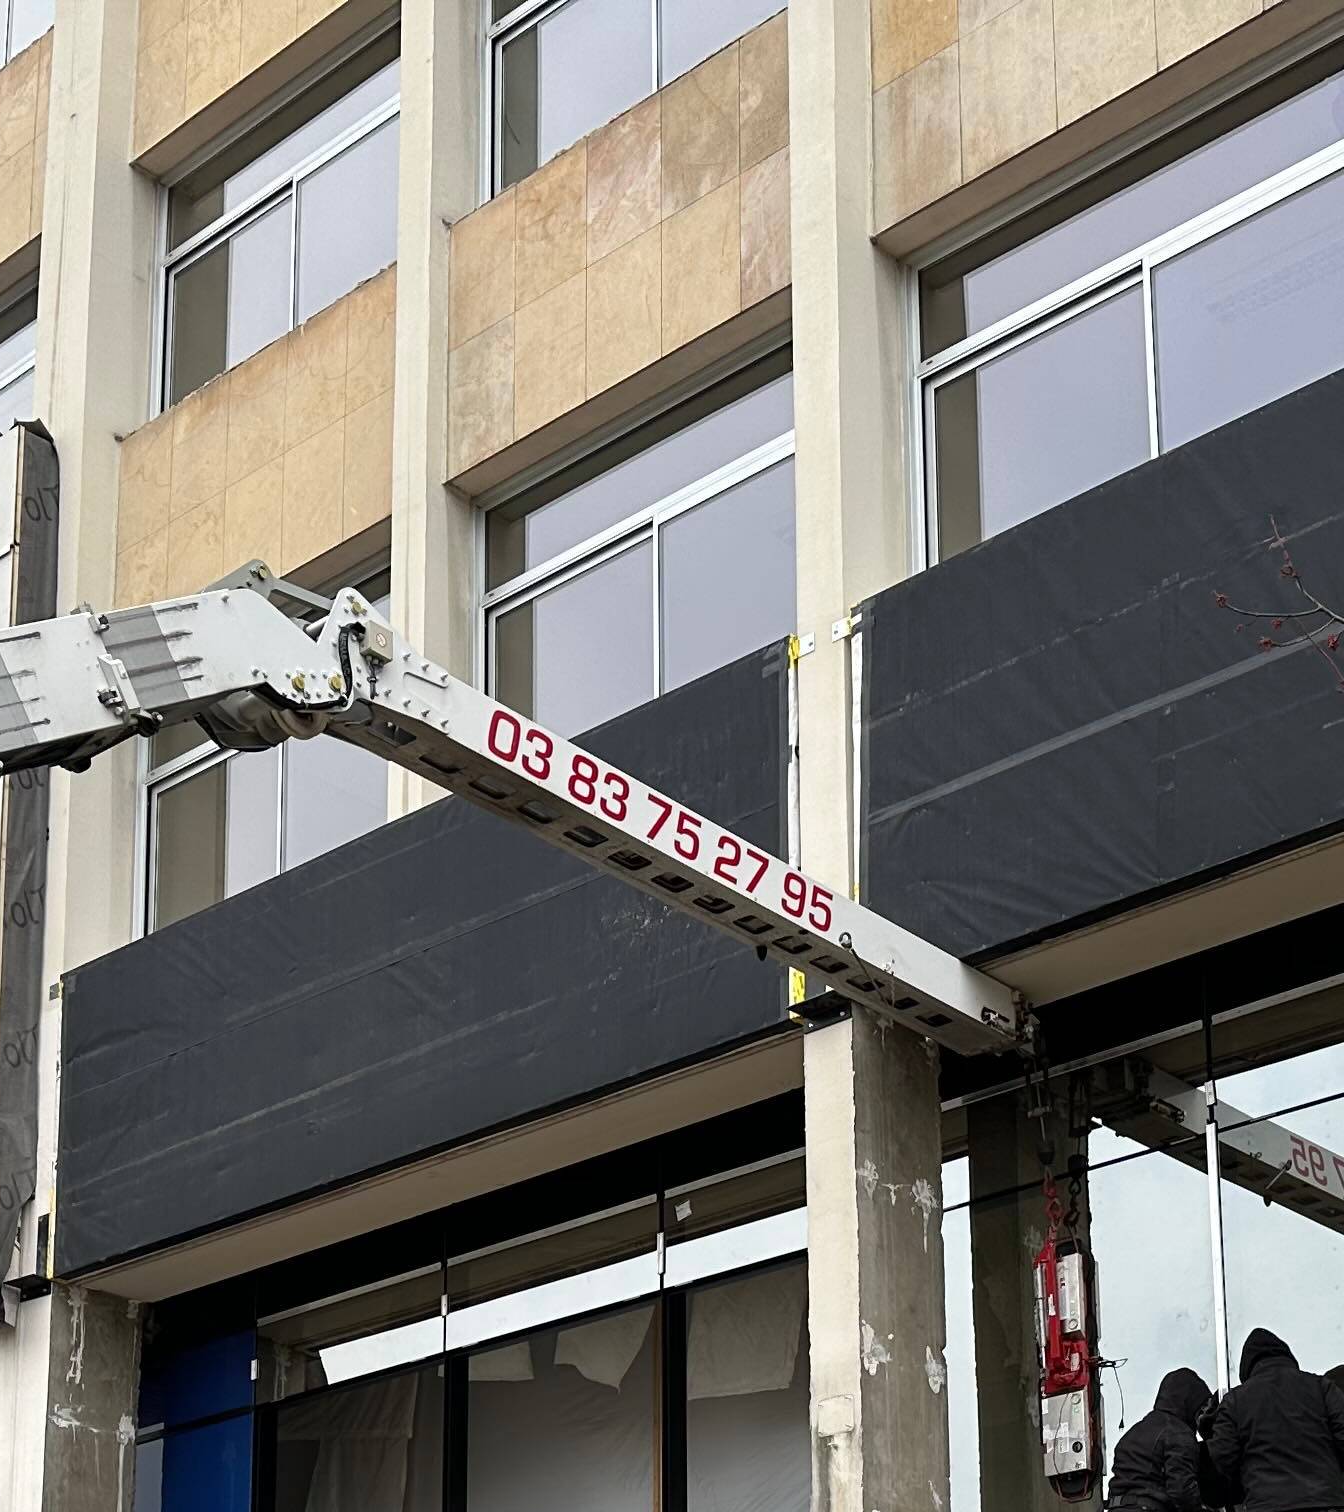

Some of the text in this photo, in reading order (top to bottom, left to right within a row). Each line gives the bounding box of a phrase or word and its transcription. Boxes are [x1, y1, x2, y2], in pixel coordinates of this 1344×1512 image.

[488, 709, 834, 932] 03 83 75 27 95
